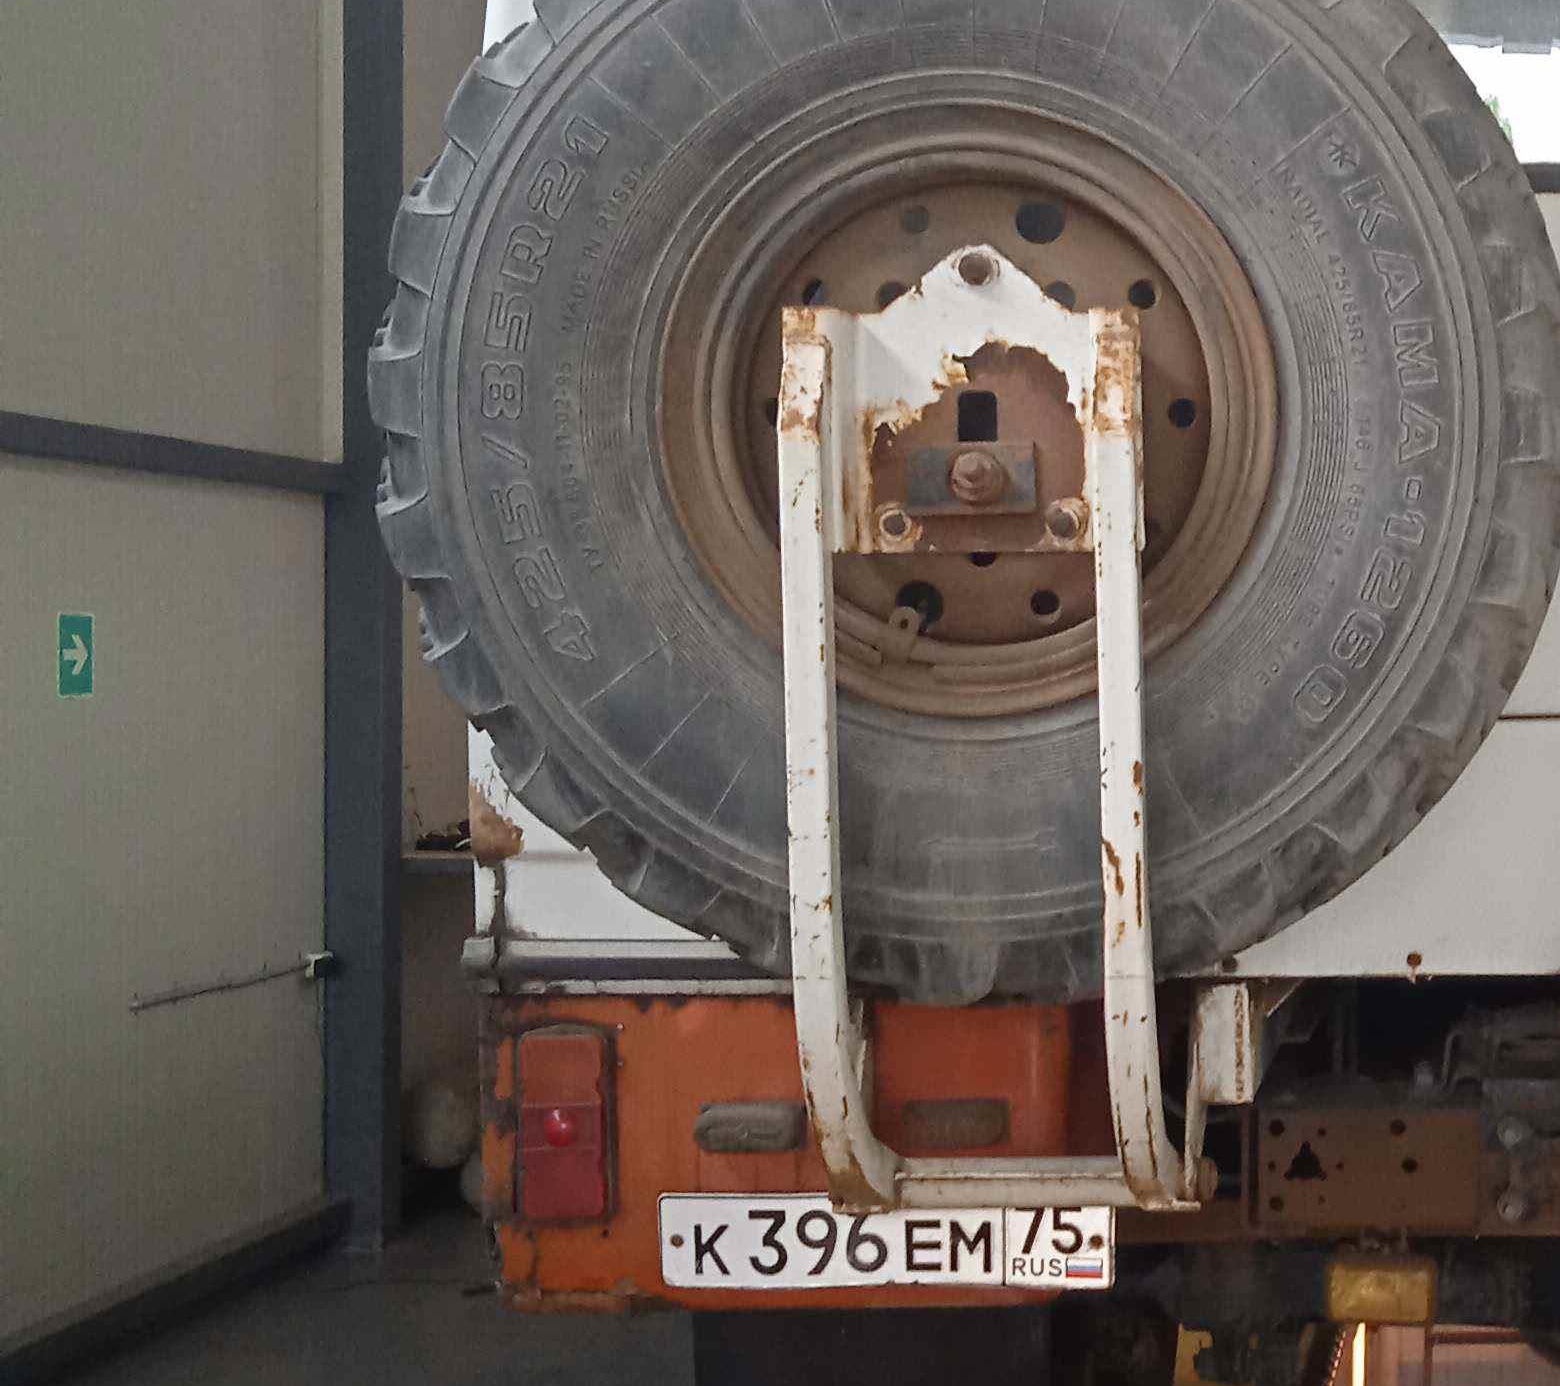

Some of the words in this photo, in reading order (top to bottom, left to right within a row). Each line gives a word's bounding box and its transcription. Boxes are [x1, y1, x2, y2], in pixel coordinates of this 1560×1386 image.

[479, 113, 610, 662] 425/85R21
[1292, 174, 1443, 723] KAMA-1260
[1011, 1257, 1063, 1277] RUS
[1016, 1205, 1084, 1254] 75
